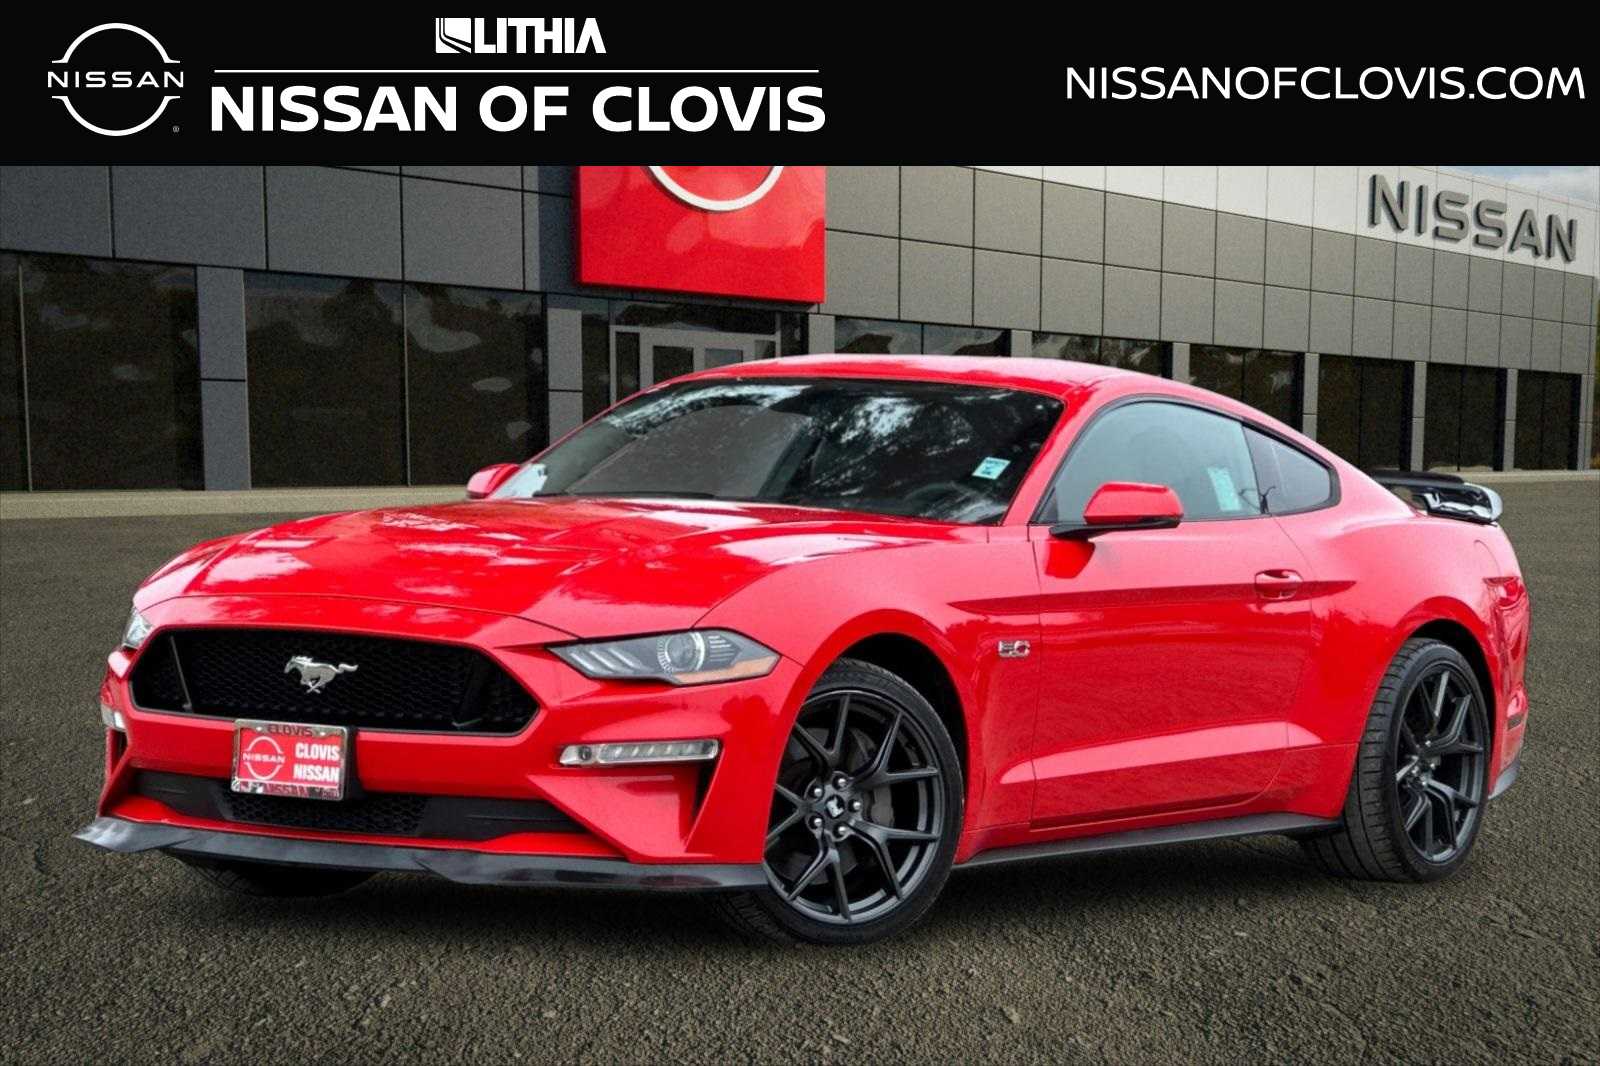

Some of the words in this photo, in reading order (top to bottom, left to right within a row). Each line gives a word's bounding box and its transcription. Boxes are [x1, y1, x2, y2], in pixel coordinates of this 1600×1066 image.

[1368, 173, 1578, 263] NISSAN
[267, 724, 314, 736] CLOVIS
[242, 752, 285, 763] NISSAN
[295, 742, 340, 760] CLOVIS
[293, 763, 340, 782] NISSAN
